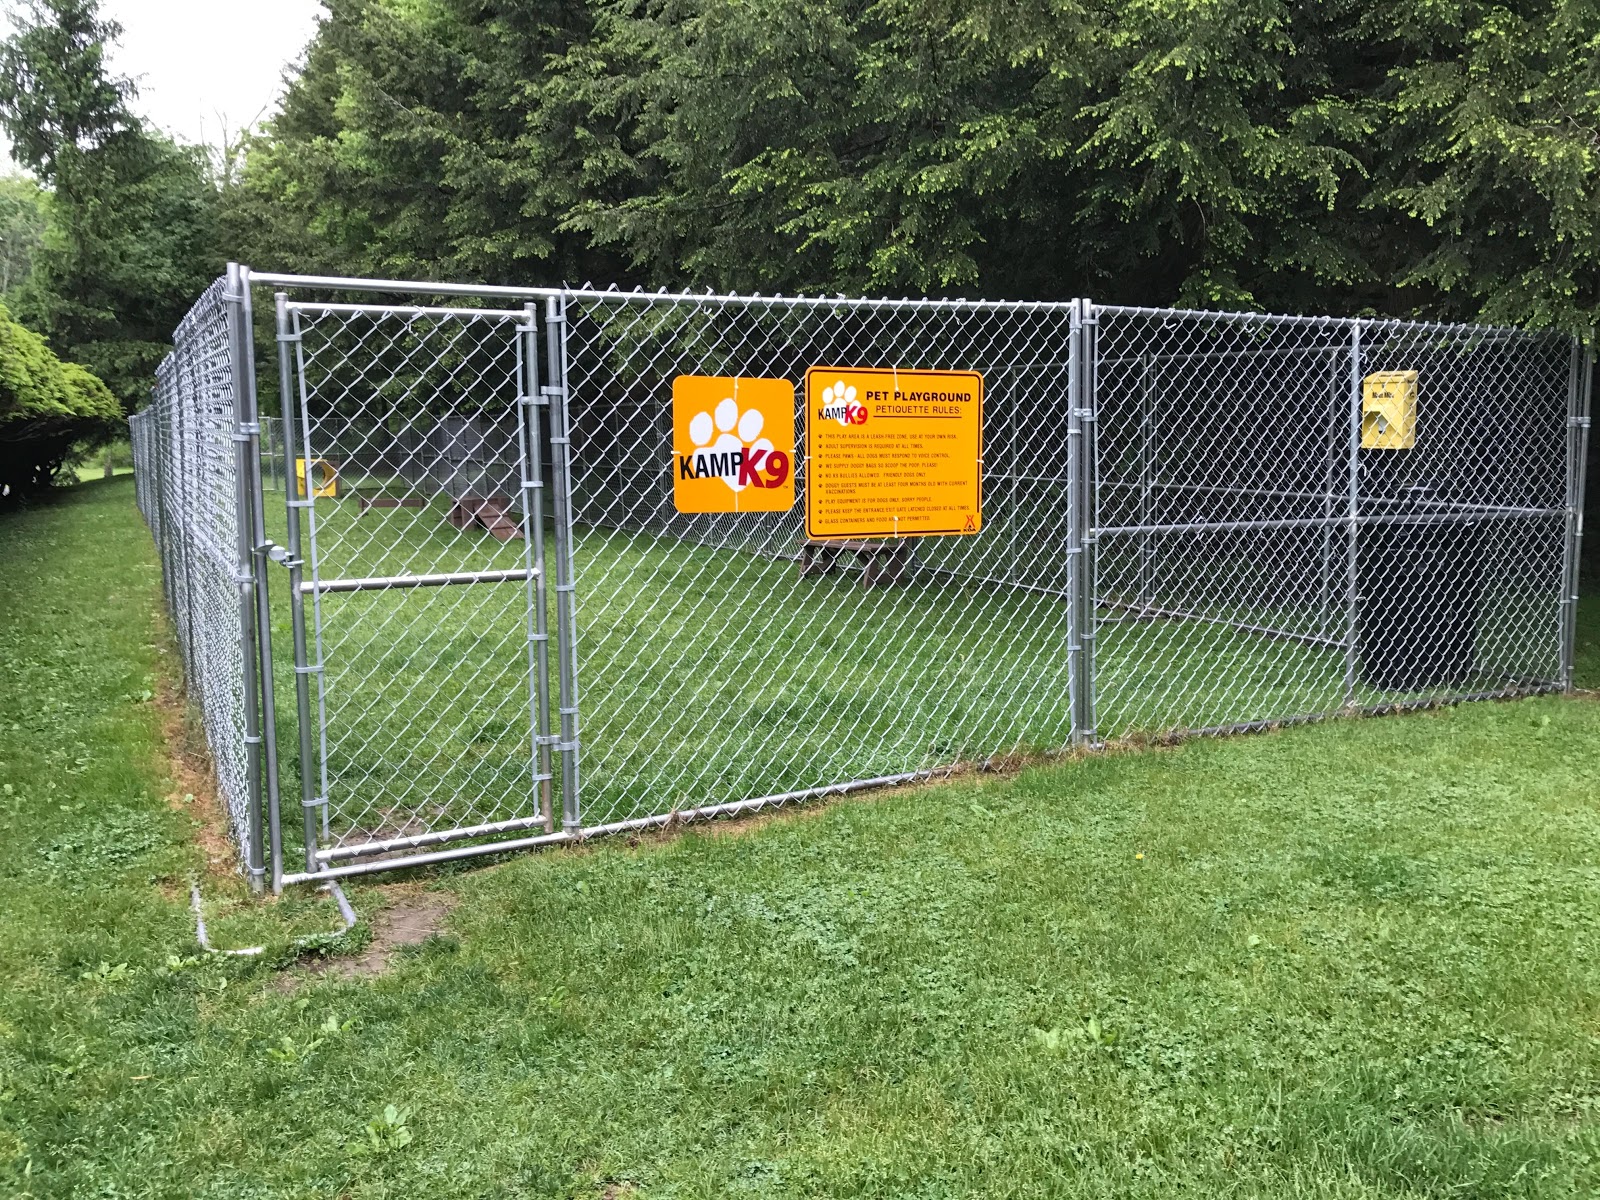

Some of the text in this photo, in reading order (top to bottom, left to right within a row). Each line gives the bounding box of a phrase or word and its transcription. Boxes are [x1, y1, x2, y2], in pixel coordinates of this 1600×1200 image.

[866, 390, 971, 402] PET PLAYGROUND
[875, 405, 962, 415] PETIQUETTE RULES:
[680, 447, 789, 489] KAMP K9
